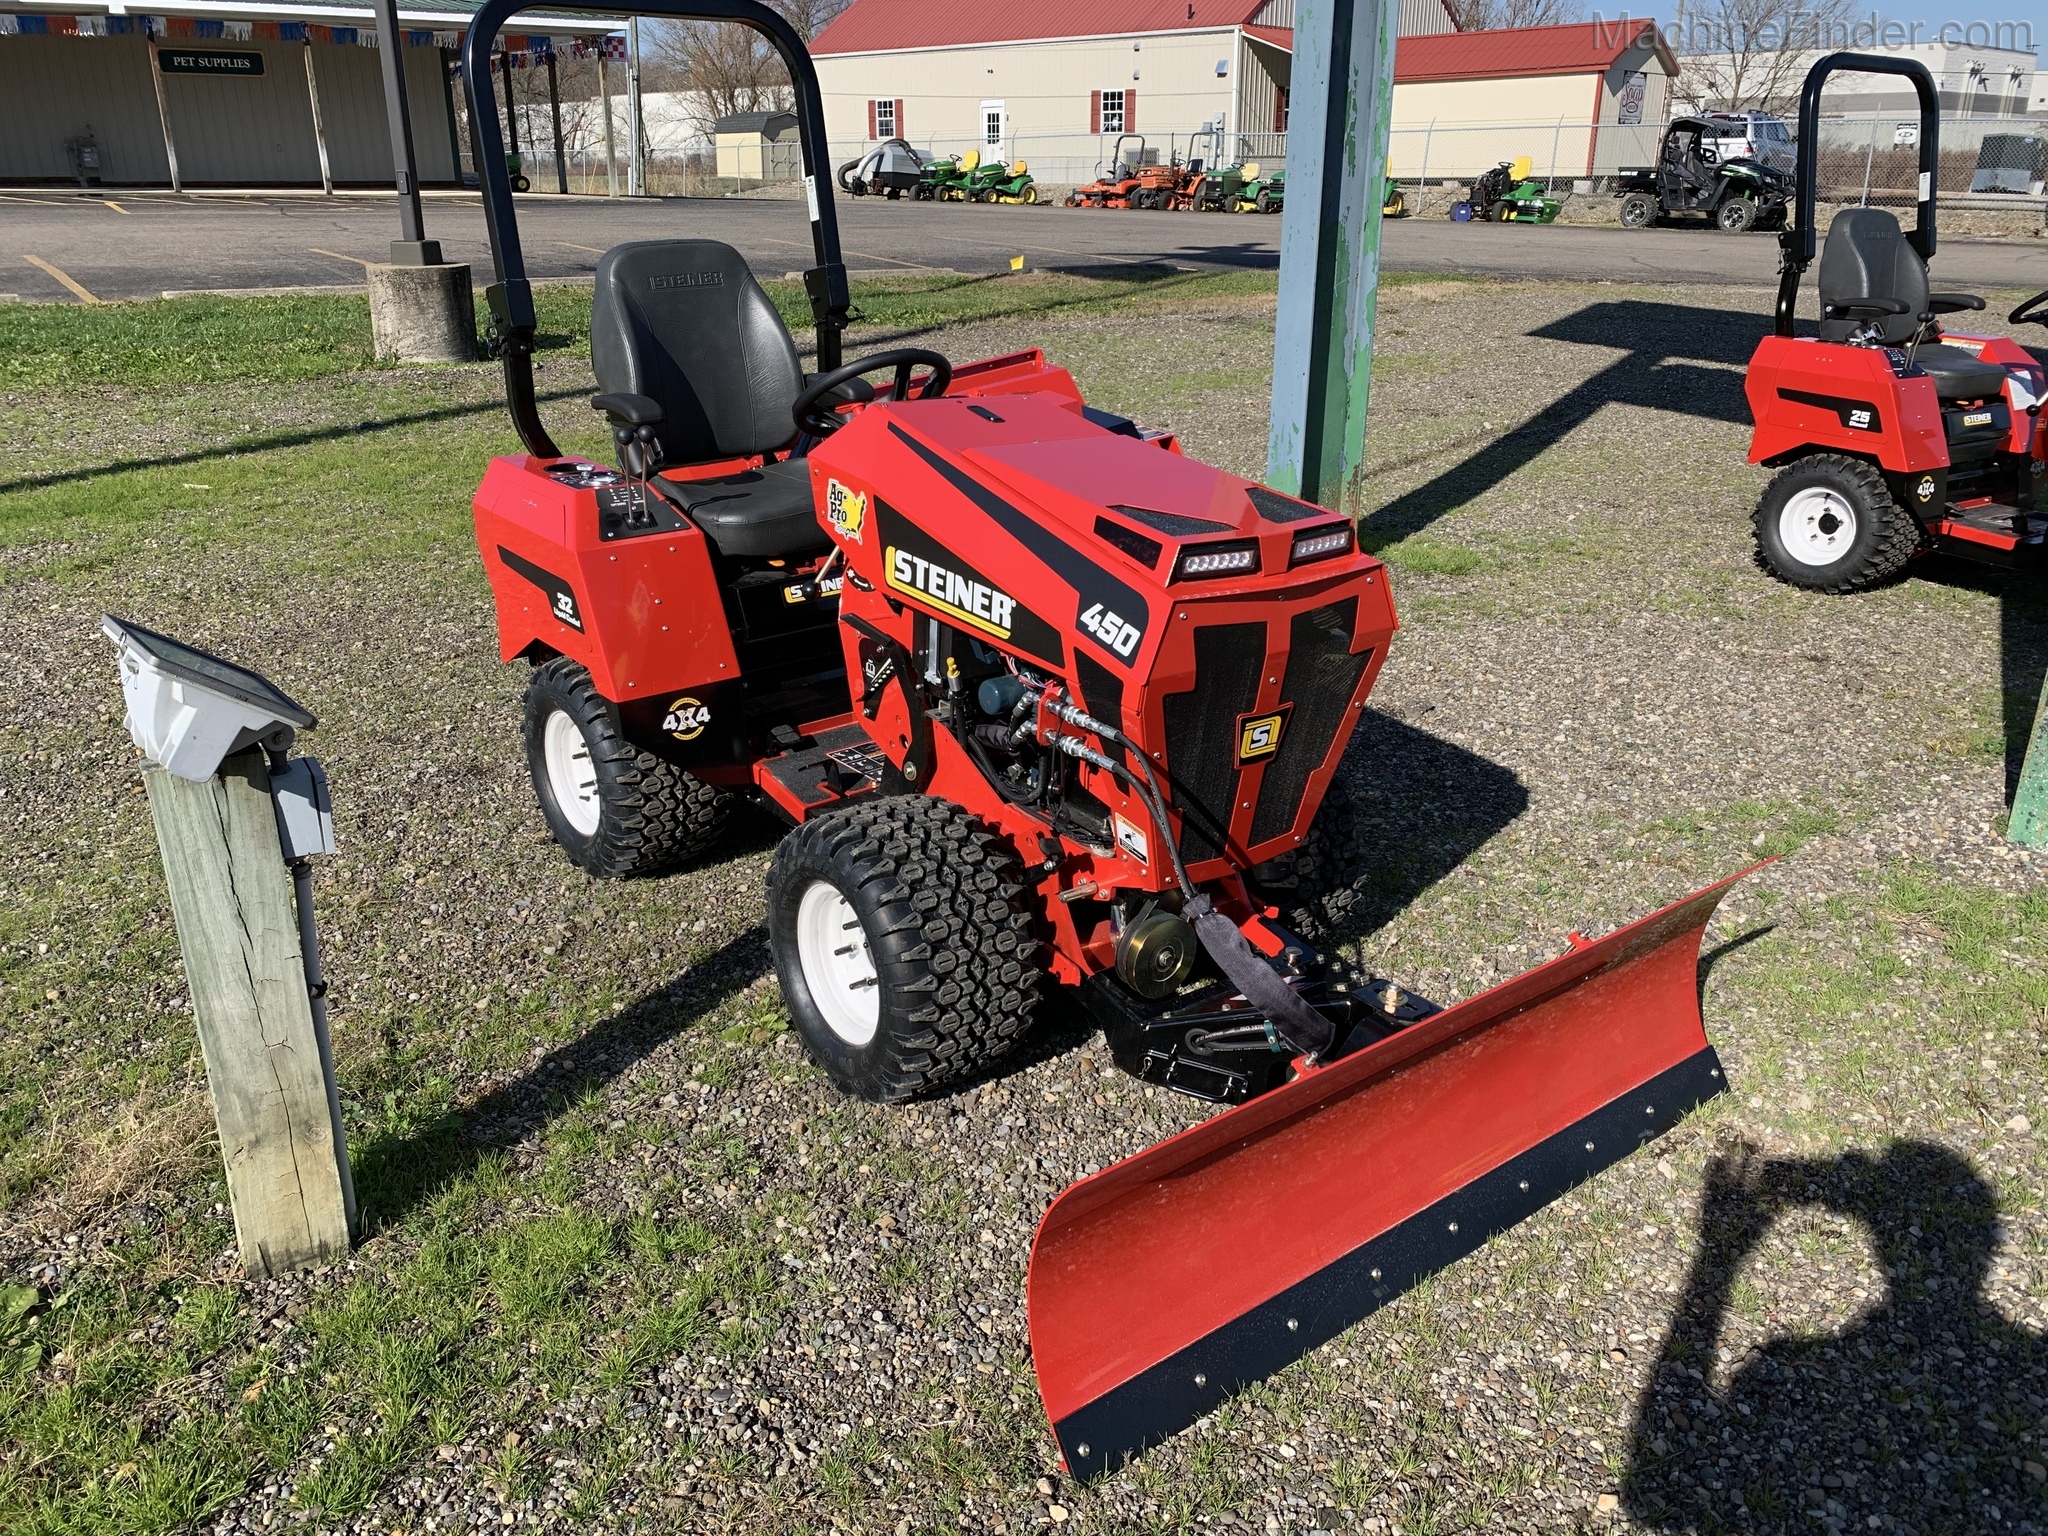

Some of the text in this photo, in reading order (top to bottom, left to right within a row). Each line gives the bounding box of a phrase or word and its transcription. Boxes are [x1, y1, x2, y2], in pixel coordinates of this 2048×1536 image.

[173, 56, 251, 68] PET SUPPLIES
[1850, 409, 1871, 423] 25
[1965, 412, 1992, 424] STEINER
[830, 483, 847, 507] Ag-
[1917, 482, 1935, 496] 4X4
[830, 501, 847, 523] Pro
[894, 549, 1012, 630] STEINER
[557, 592, 574, 615] 32
[1080, 602, 1141, 657] 450
[662, 706, 711, 731] 4X4
[1250, 724, 1271, 749] S
